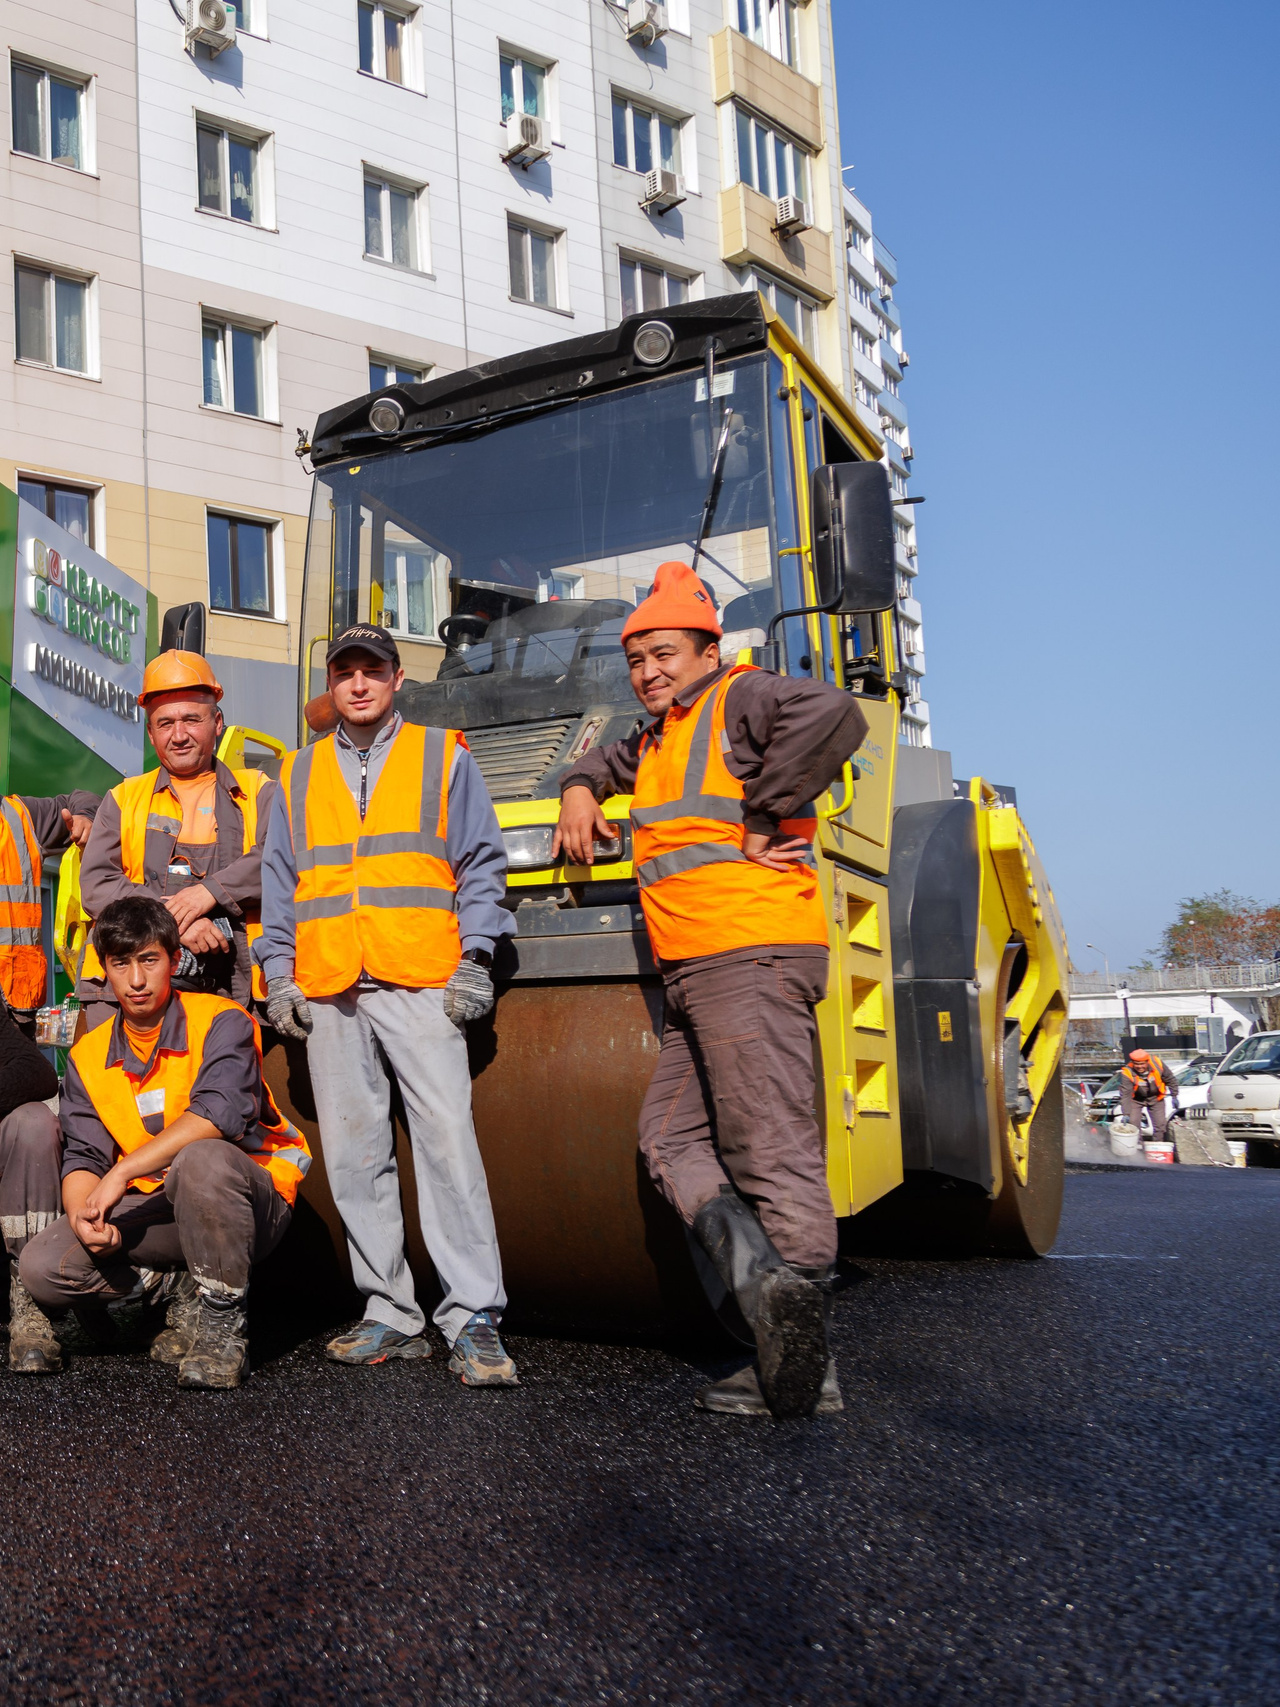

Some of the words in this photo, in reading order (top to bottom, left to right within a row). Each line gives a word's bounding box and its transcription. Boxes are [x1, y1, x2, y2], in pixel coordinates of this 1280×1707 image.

[61, 559, 140, 635] КВАРТЕТ
[63, 597, 132, 664] ВКУСОВ
[29, 643, 140, 723] МИНИМАРКЕТ
[860, 738, 884, 760] ХНО
